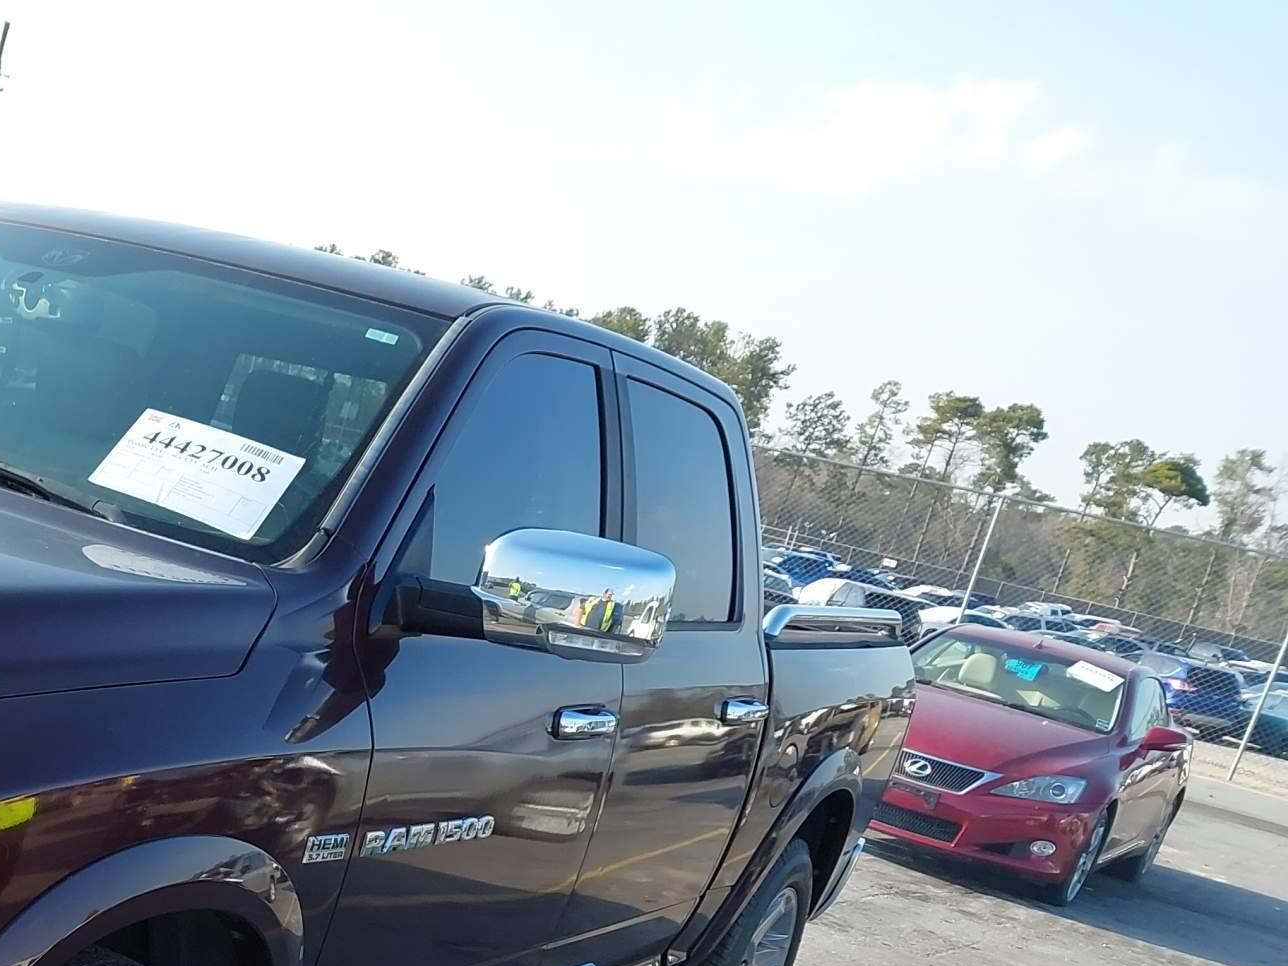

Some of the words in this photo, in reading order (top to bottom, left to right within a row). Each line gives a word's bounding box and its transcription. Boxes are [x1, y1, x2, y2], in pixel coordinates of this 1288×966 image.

[143, 430, 271, 483] 44427008
[309, 836, 349, 852] HEMI
[360, 824, 435, 856] RAM
[435, 815, 496, 846] 1500
[322, 851, 343, 860] LITER
